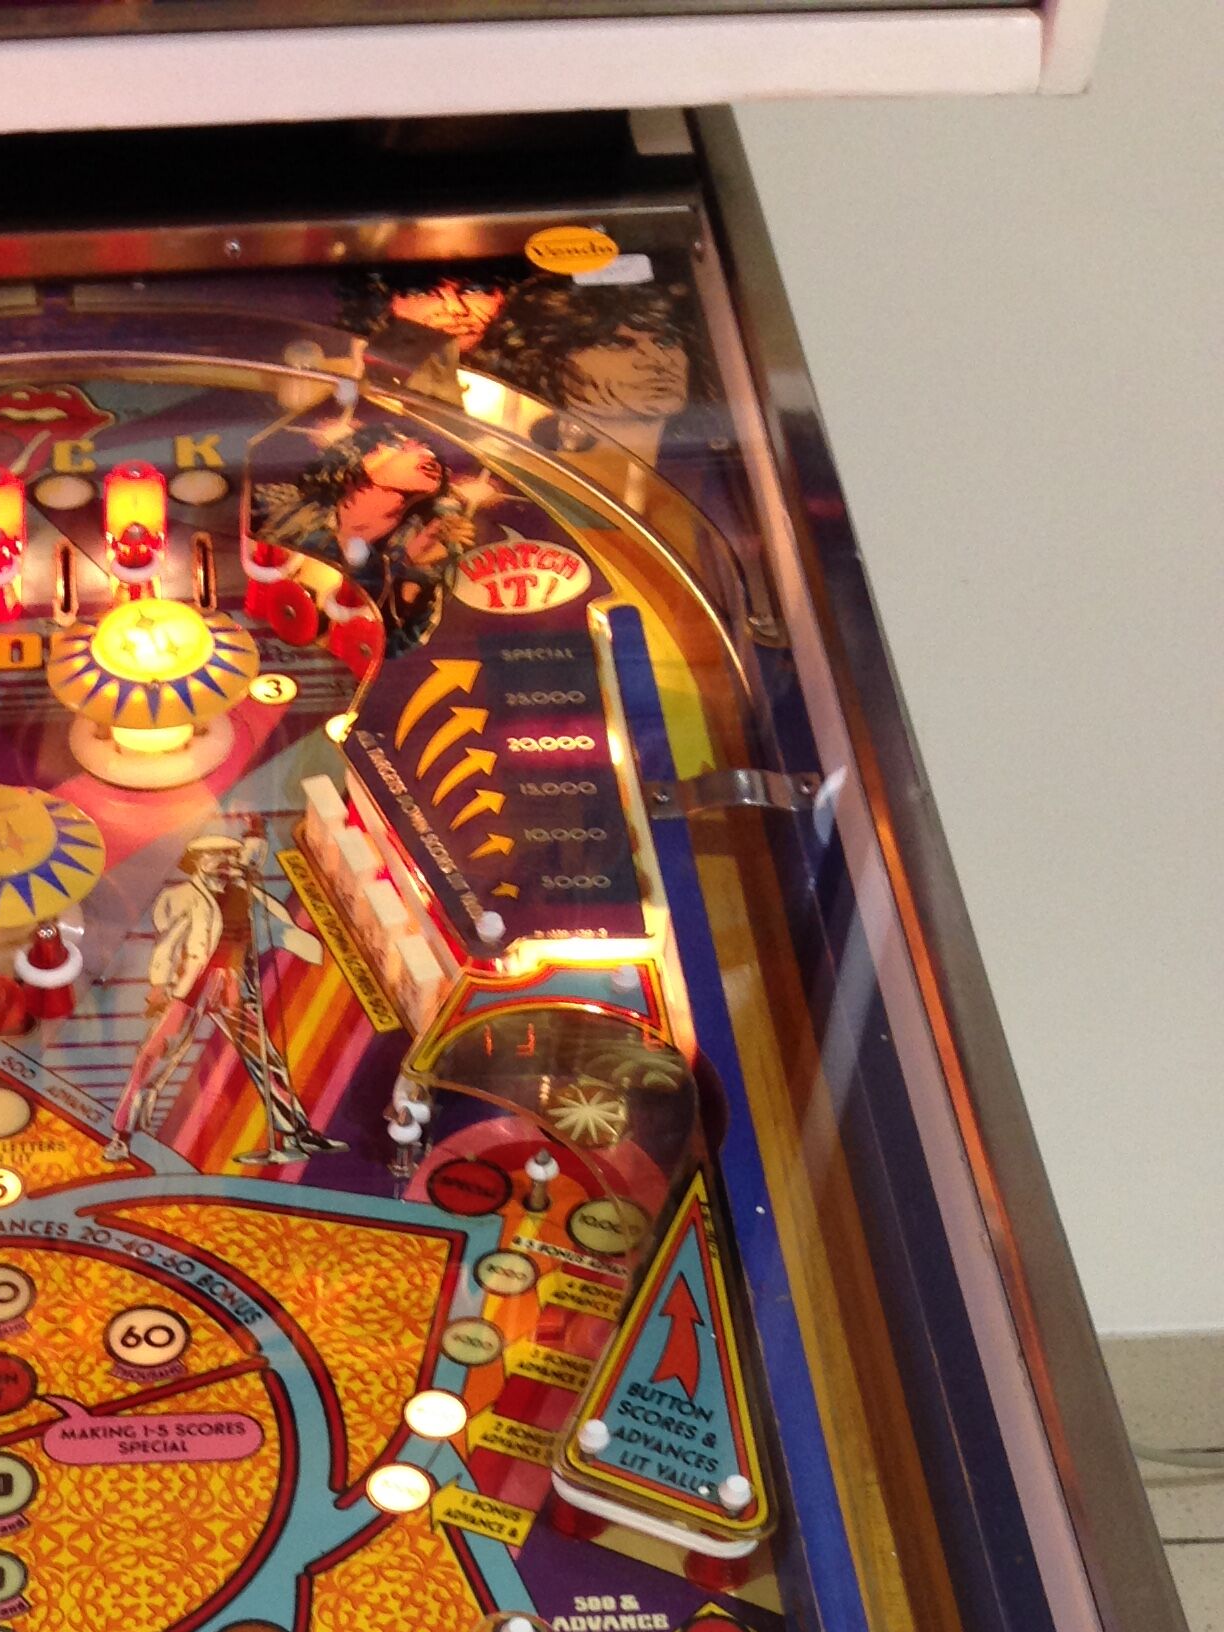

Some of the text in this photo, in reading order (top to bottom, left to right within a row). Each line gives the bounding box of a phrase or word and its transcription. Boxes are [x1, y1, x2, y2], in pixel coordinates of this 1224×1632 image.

[53, 439, 95, 471] C
[176, 435, 226, 469] K
[458, 542, 581, 582] WATCH
[265, 679, 282, 699] 3
[506, 736, 595, 752] 20,000
[196, 1273, 264, 1326] BONUS
[119, 1325, 175, 1349] 60
[59, 1422, 246, 1442] MAKING 1-5 SCORES
[118, 1441, 190, 1455] SPECIAL
[574, 1595, 640, 1611] 500 &
[552, 1614, 670, 1632] ADVANCE
